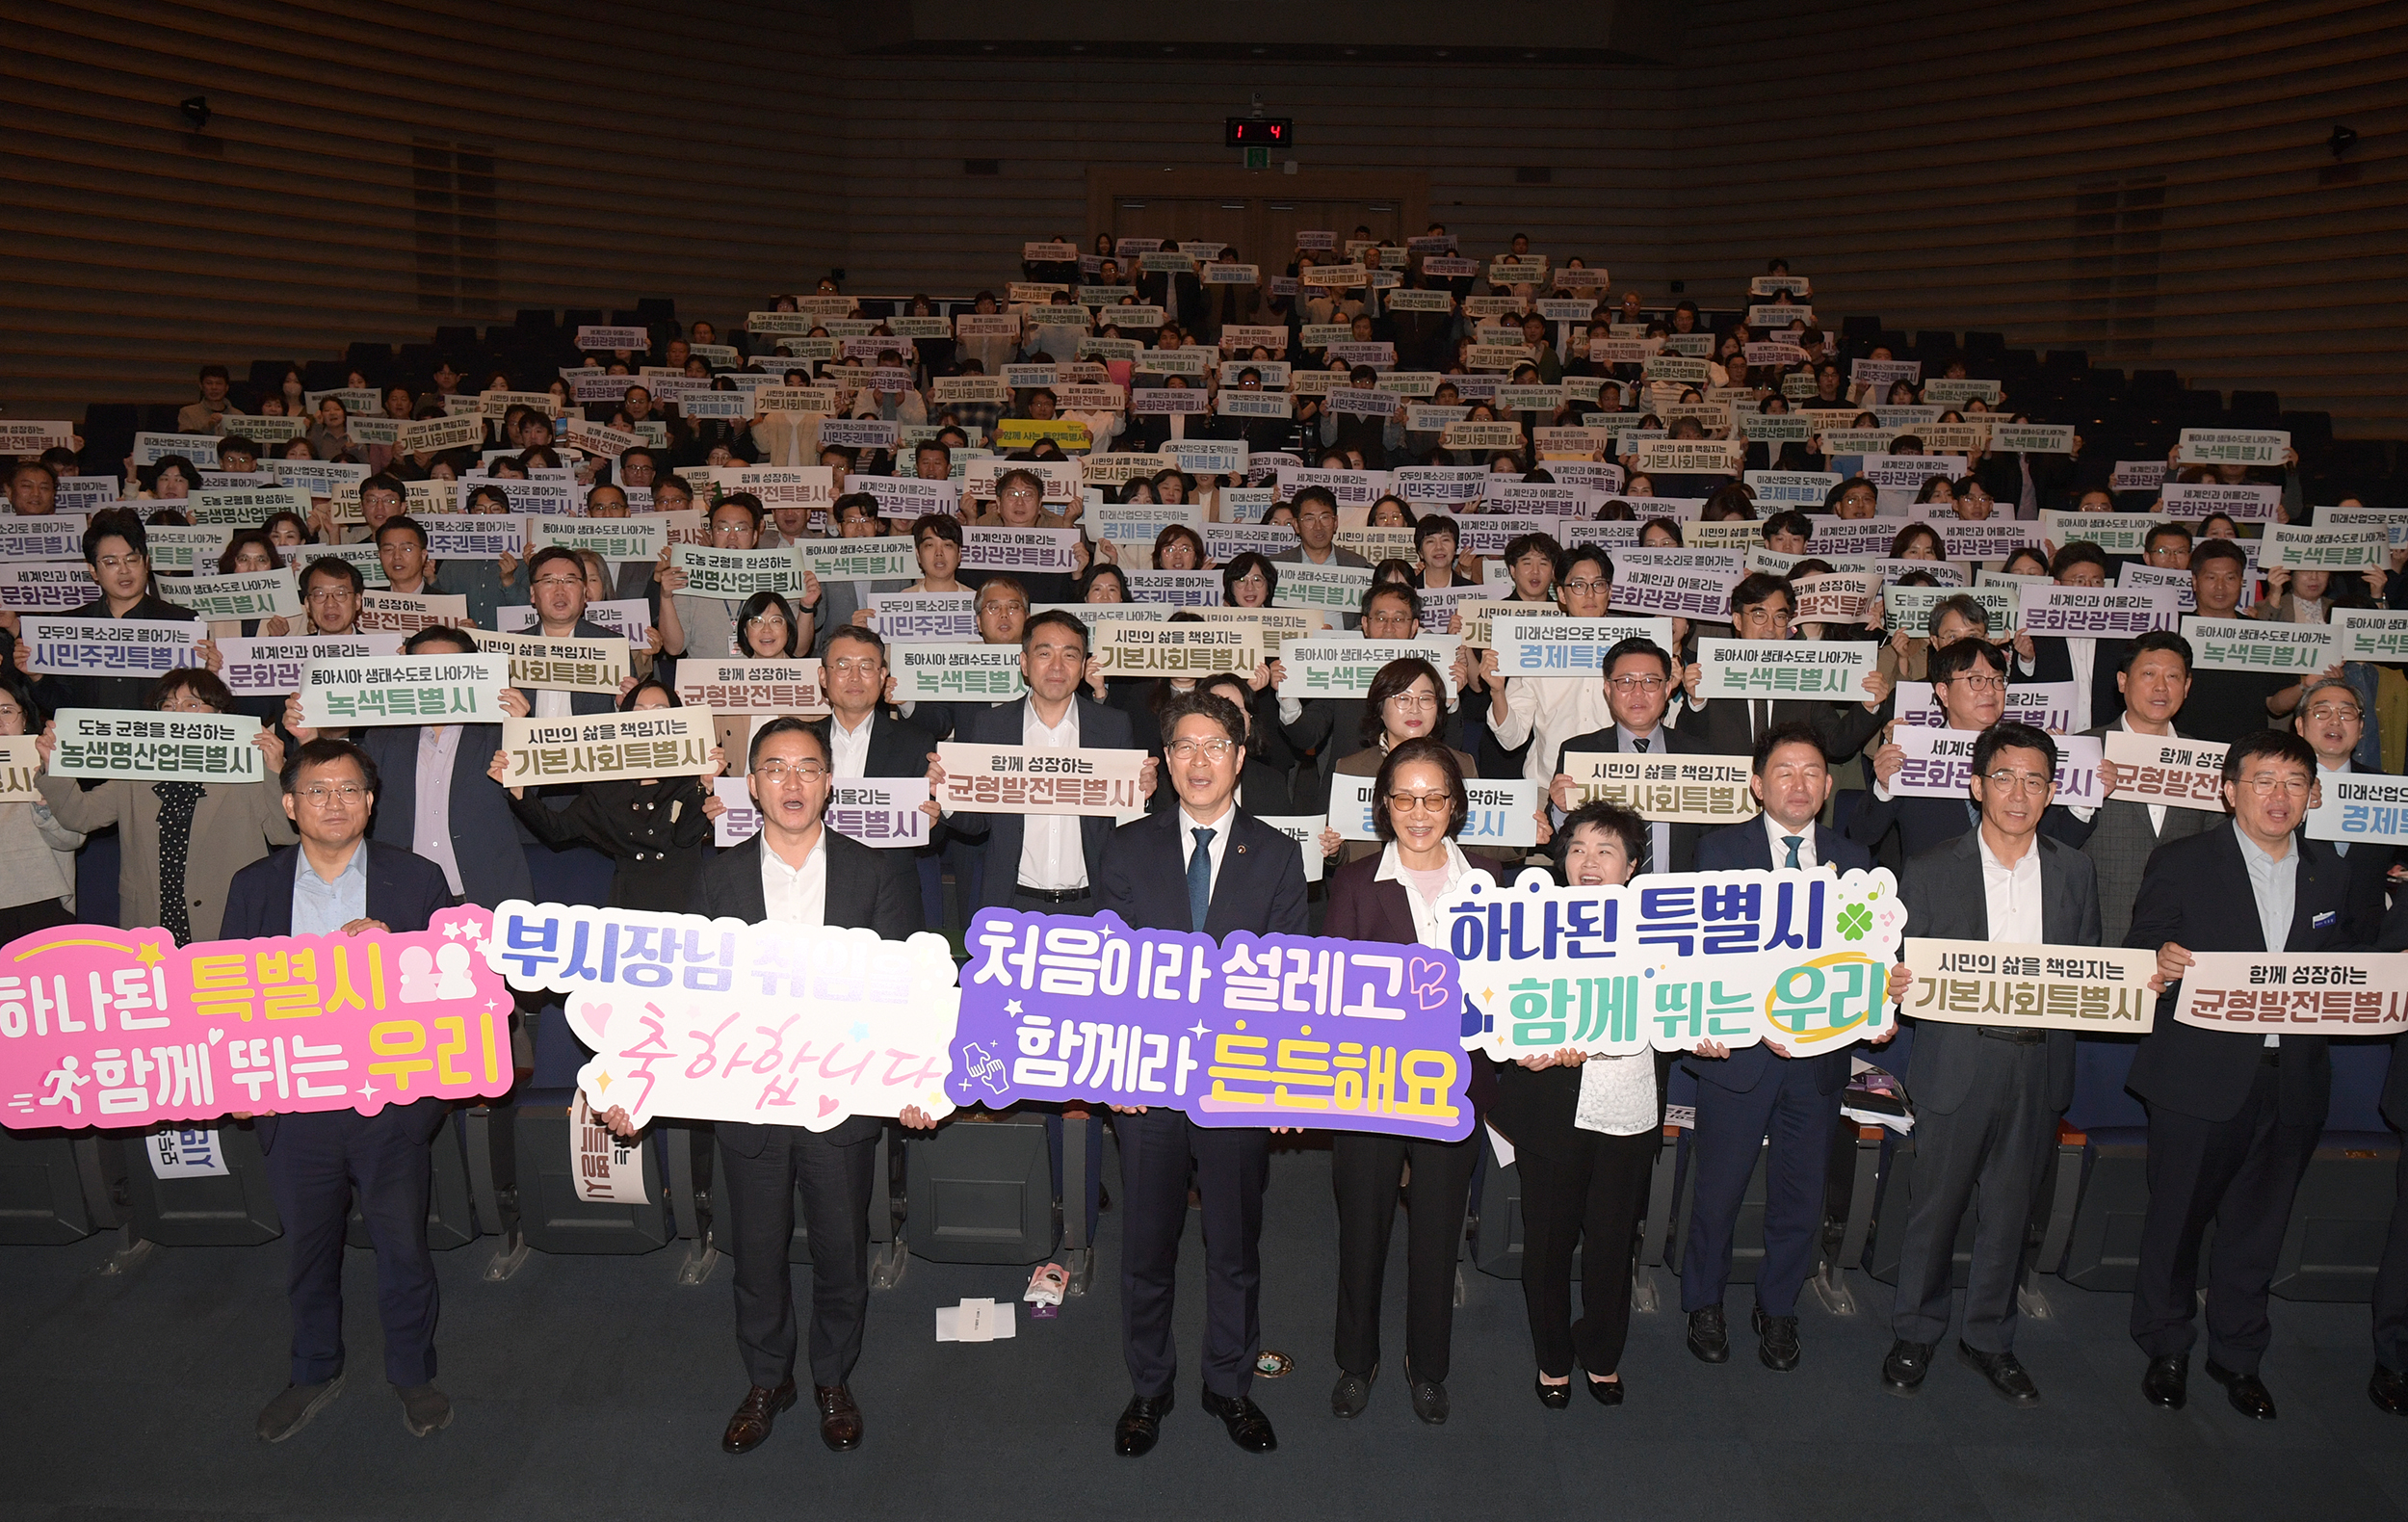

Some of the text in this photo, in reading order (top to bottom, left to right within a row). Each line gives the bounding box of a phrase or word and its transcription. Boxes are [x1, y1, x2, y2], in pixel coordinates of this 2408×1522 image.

[1270, 125, 1281, 139] 4
[687, 403, 742, 415] 경제특별시
[759, 399, 830, 410] 기본사회특별시
[2195, 445, 2272, 460] 녹색특별시
[1643, 455, 1734, 469] 기본사회특별시
[763, 473, 800, 483] 성장하는
[2183, 490, 2220, 499] 세계인과
[542, 522, 655, 535] 동아시아 생태수도로 나아가는
[1946, 527, 2025, 536] 세계인과 어울리는
[2276, 532, 2386, 543] 동아시아 생태수도로 나아가는
[971, 534, 1056, 544] 세계인과 어울리는
[805, 542, 913, 556] 동아시아 생태수도로 나아가는
[2282, 545, 2380, 564] 녹색특별시
[685, 553, 792, 568] 도농 균형을 완성하는
[815, 557, 904, 575] 녹색특별시
[194, 582, 240, 595] 생태수도로
[243, 579, 281, 590] 나아가는
[688, 568, 802, 592] 생명산업특별시
[1627, 572, 1723, 591] 세계인과 어울리는
[1819, 582, 1867, 594] 성장하는
[880, 600, 958, 612] 모두의 목소리로
[2049, 594, 2153, 609] 세계인과 어울리는
[2026, 609, 2171, 633] 문화관광특별시
[39, 626, 190, 643] 모두의 목소리로 열어가는
[1115, 630, 1243, 643] 시민의 삶을 책임지는
[1515, 627, 1594, 640] 미래산업으로
[2196, 626, 2331, 644] 동아시아 생태수도로 나아가는
[35, 643, 196, 669] 시민주권특별시
[251, 643, 370, 661] 세계인과 어울리는
[519, 643, 546, 657] 삶을
[550, 645, 606, 660] 책임지는
[904, 653, 1001, 666] 동아시아 생태수도로
[1100, 645, 1257, 672] 기본사회특별시
[1295, 648, 1338, 663] 동아시아
[1341, 648, 1394, 661] 생태수도로
[1714, 648, 1863, 664] 동아시아 생태수도로 나아가는
[2203, 642, 2317, 668] 녹색특별시
[311, 666, 488, 685] 동아시아 생태수도로 나아가는
[510, 662, 620, 687] 사회특별시
[718, 667, 801, 681] 함께 성장하는
[1722, 667, 1848, 693] 녹색특별시
[326, 687, 477, 718] 녹색특별시
[79, 720, 235, 741] 도농 균형을 완성하는
[528, 719, 687, 744] 시민의 삶을 책임지는
[61, 740, 252, 774] 농생명산업특별시
[512, 738, 706, 777] 기본사회특별시
[991, 755, 1093, 774] 함께 성장하는
[2159, 748, 2192, 766] 함께
[1591, 764, 1747, 782] 시민의 삶을 책임지는
[2118, 764, 2224, 800] 균형발전
[946, 774, 1134, 807] 균형발전특별시
[1449, 880, 1825, 962] 하나된 특별시
[501, 914, 736, 992] 부시장님
[973, 920, 1407, 1021] 처음이라 설레고
[1938, 953, 2125, 981] 시민의 삶을 책임지는
[2249, 965, 2367, 984] 함께 성장하는
[0, 942, 386, 1037] 하나된 특별시
[1507, 961, 1885, 1046] 함께 뛰는 우리
[1915, 976, 2143, 1022] 기본사회특별시
[2190, 988, 2408, 1023] 균형발전특별시
[92, 1012, 499, 1115] 함께 뛰는 우리
[618, 1001, 942, 1115] 축하합니다
[1012, 1014, 1459, 1118] 함께라 든든해요
